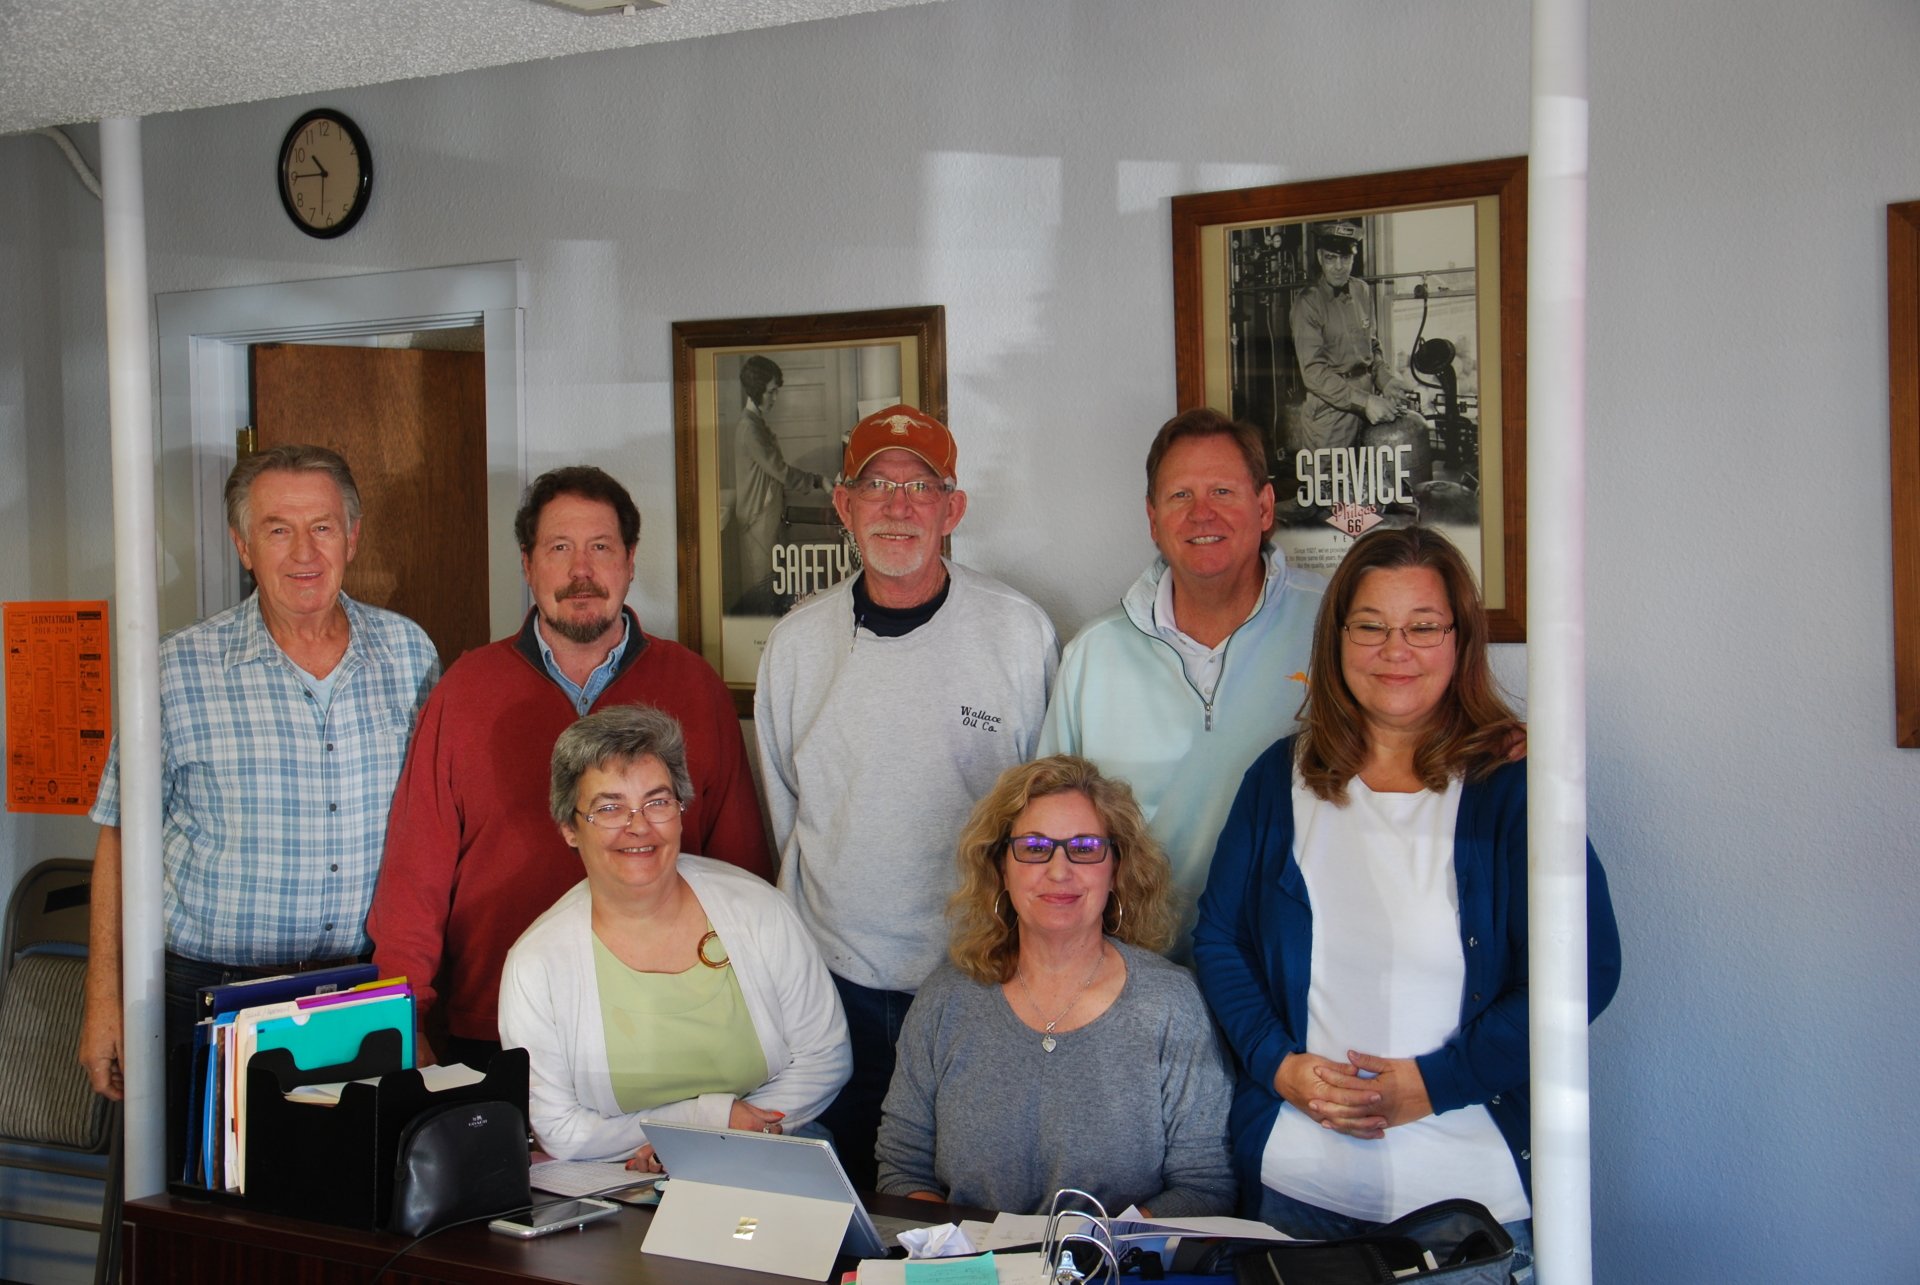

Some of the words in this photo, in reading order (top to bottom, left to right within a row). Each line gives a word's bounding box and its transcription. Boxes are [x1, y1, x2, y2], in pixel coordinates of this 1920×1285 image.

[318, 121, 330, 137] 12
[338, 126, 342, 141] 1
[305, 130, 314, 145] 11
[294, 148, 305, 163] 10
[291, 172, 298, 186] 9
[297, 193, 304, 208] 8
[309, 208, 316, 222] 7
[342, 204, 349, 215] 5
[326, 212, 334, 227] 6
[1296, 445, 1413, 507] SERVICE
[1331, 501, 1378, 526] Philgas
[1347, 519, 1362, 533] 66
[772, 543, 852, 596] SAFETY
[960, 705, 1002, 724] Wallace
[962, 716, 978, 728] Oil
[982, 721, 997, 733] Co.
